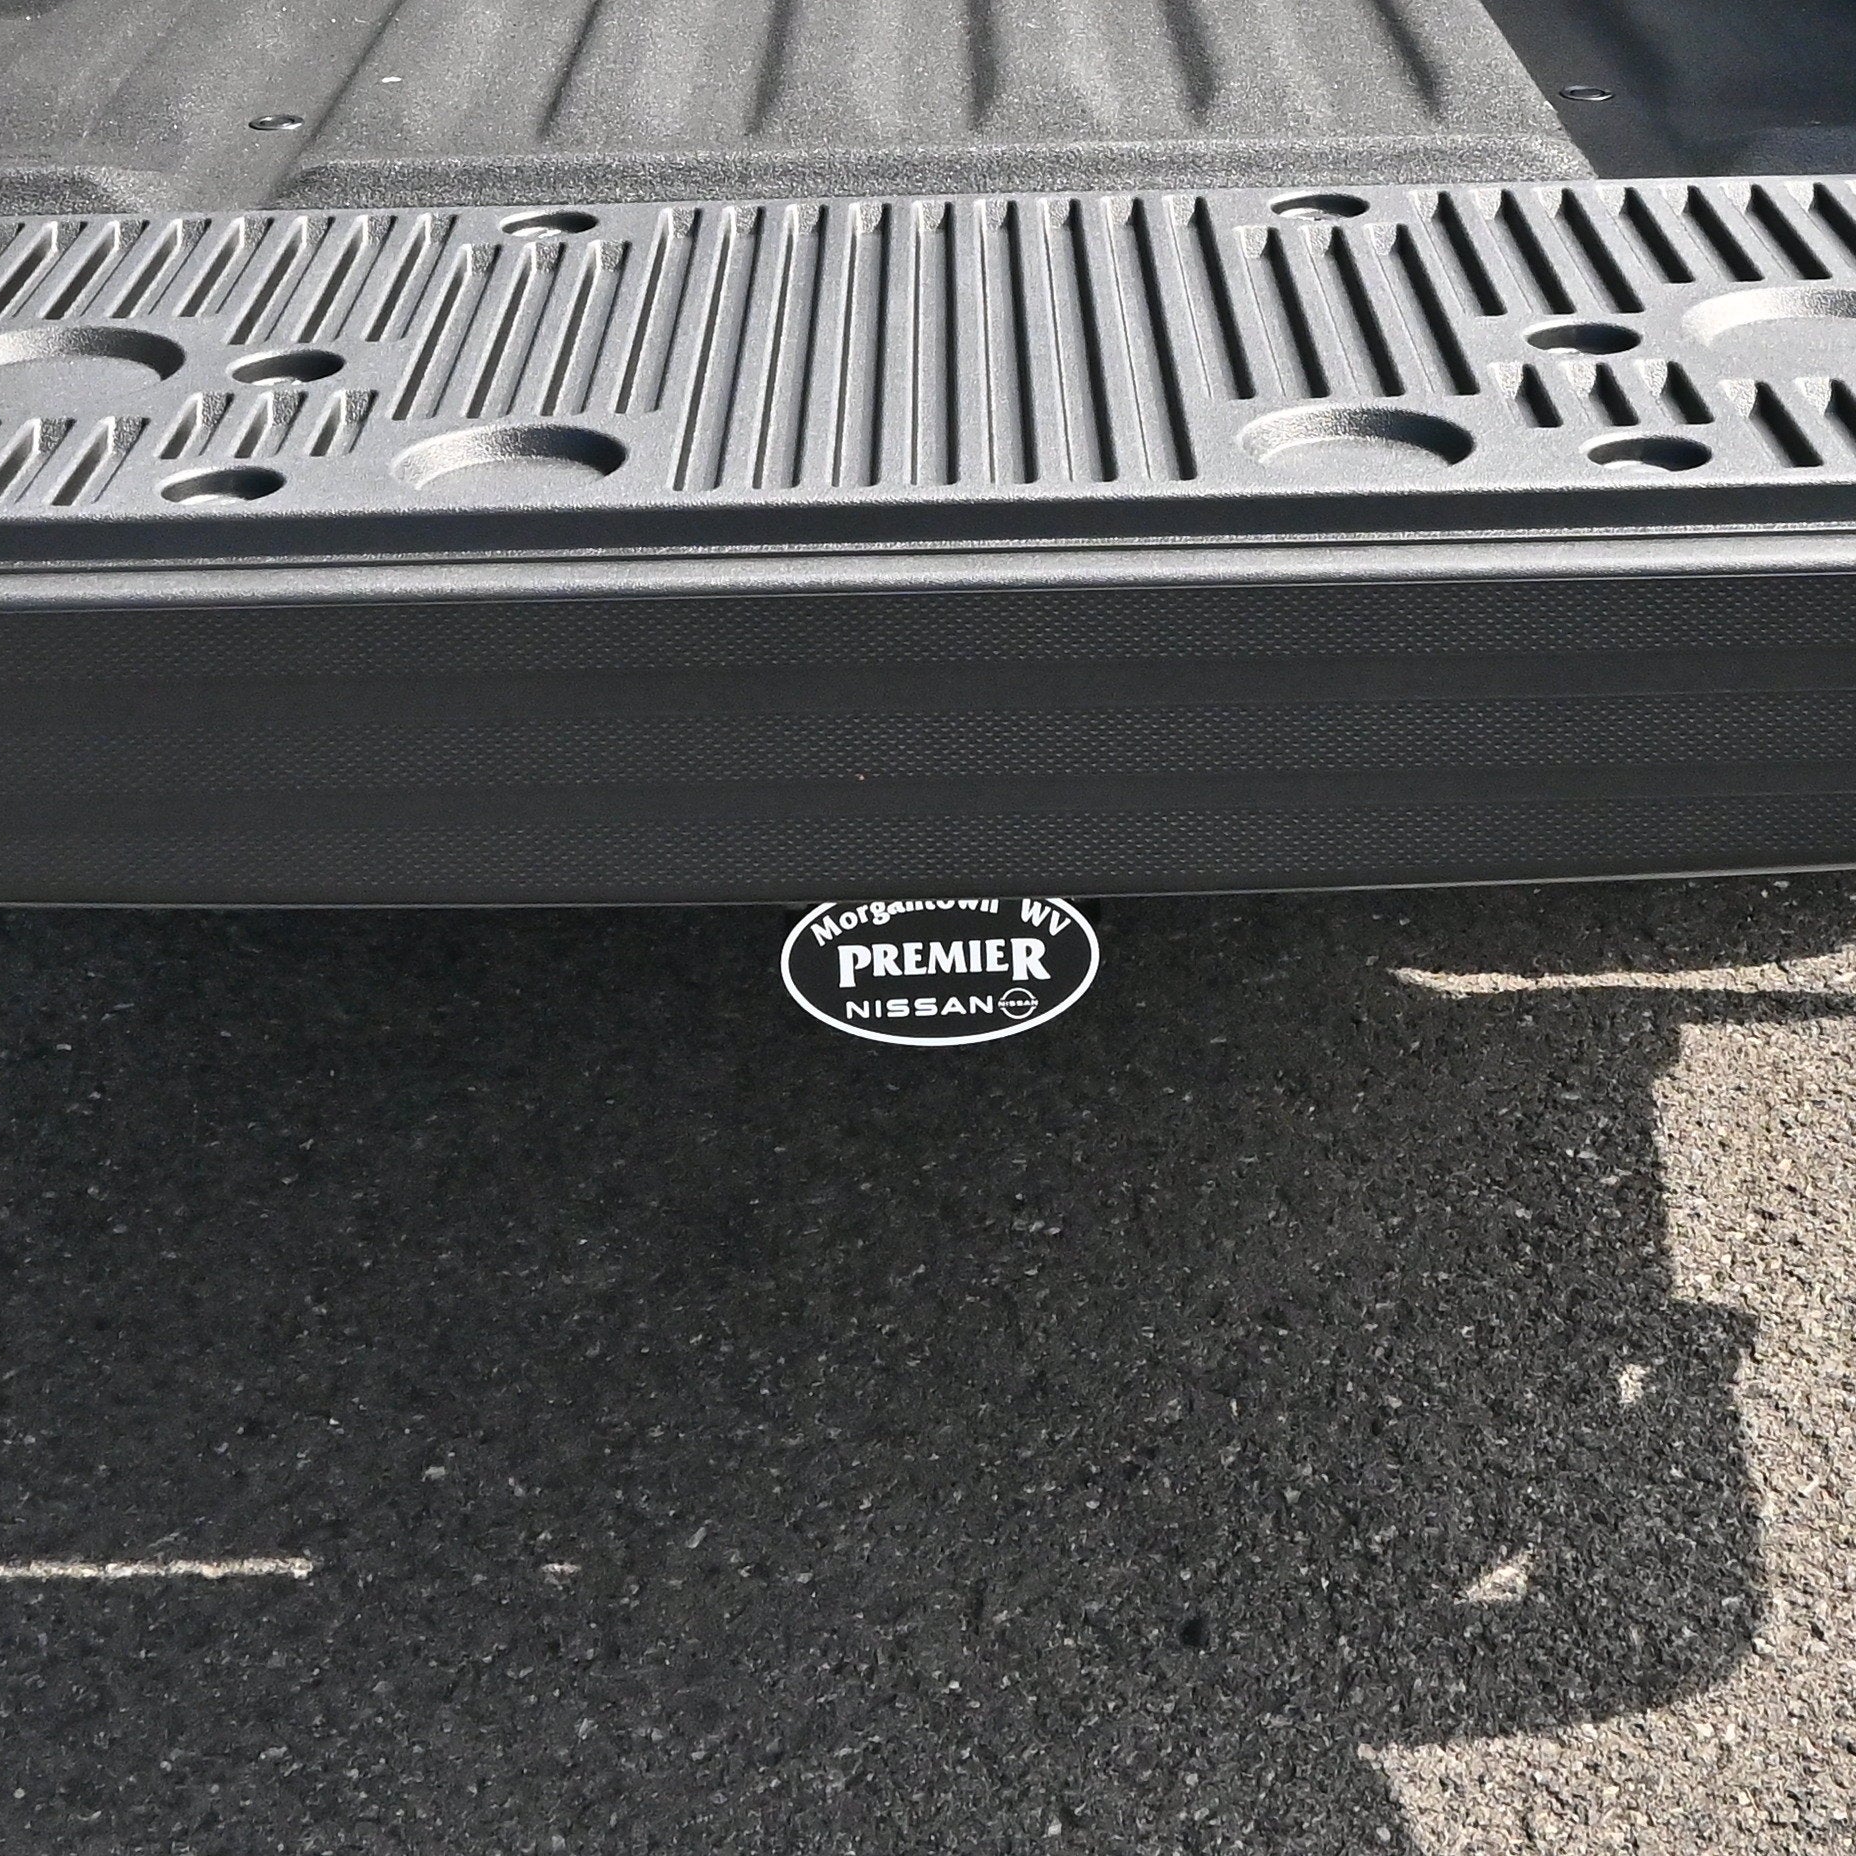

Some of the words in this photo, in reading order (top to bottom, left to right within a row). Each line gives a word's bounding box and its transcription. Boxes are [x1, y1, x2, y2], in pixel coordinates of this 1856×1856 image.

[1020, 897, 1072, 937] WV
[837, 937, 1052, 989] PREMIER
[846, 995, 994, 1020] NISSAN
